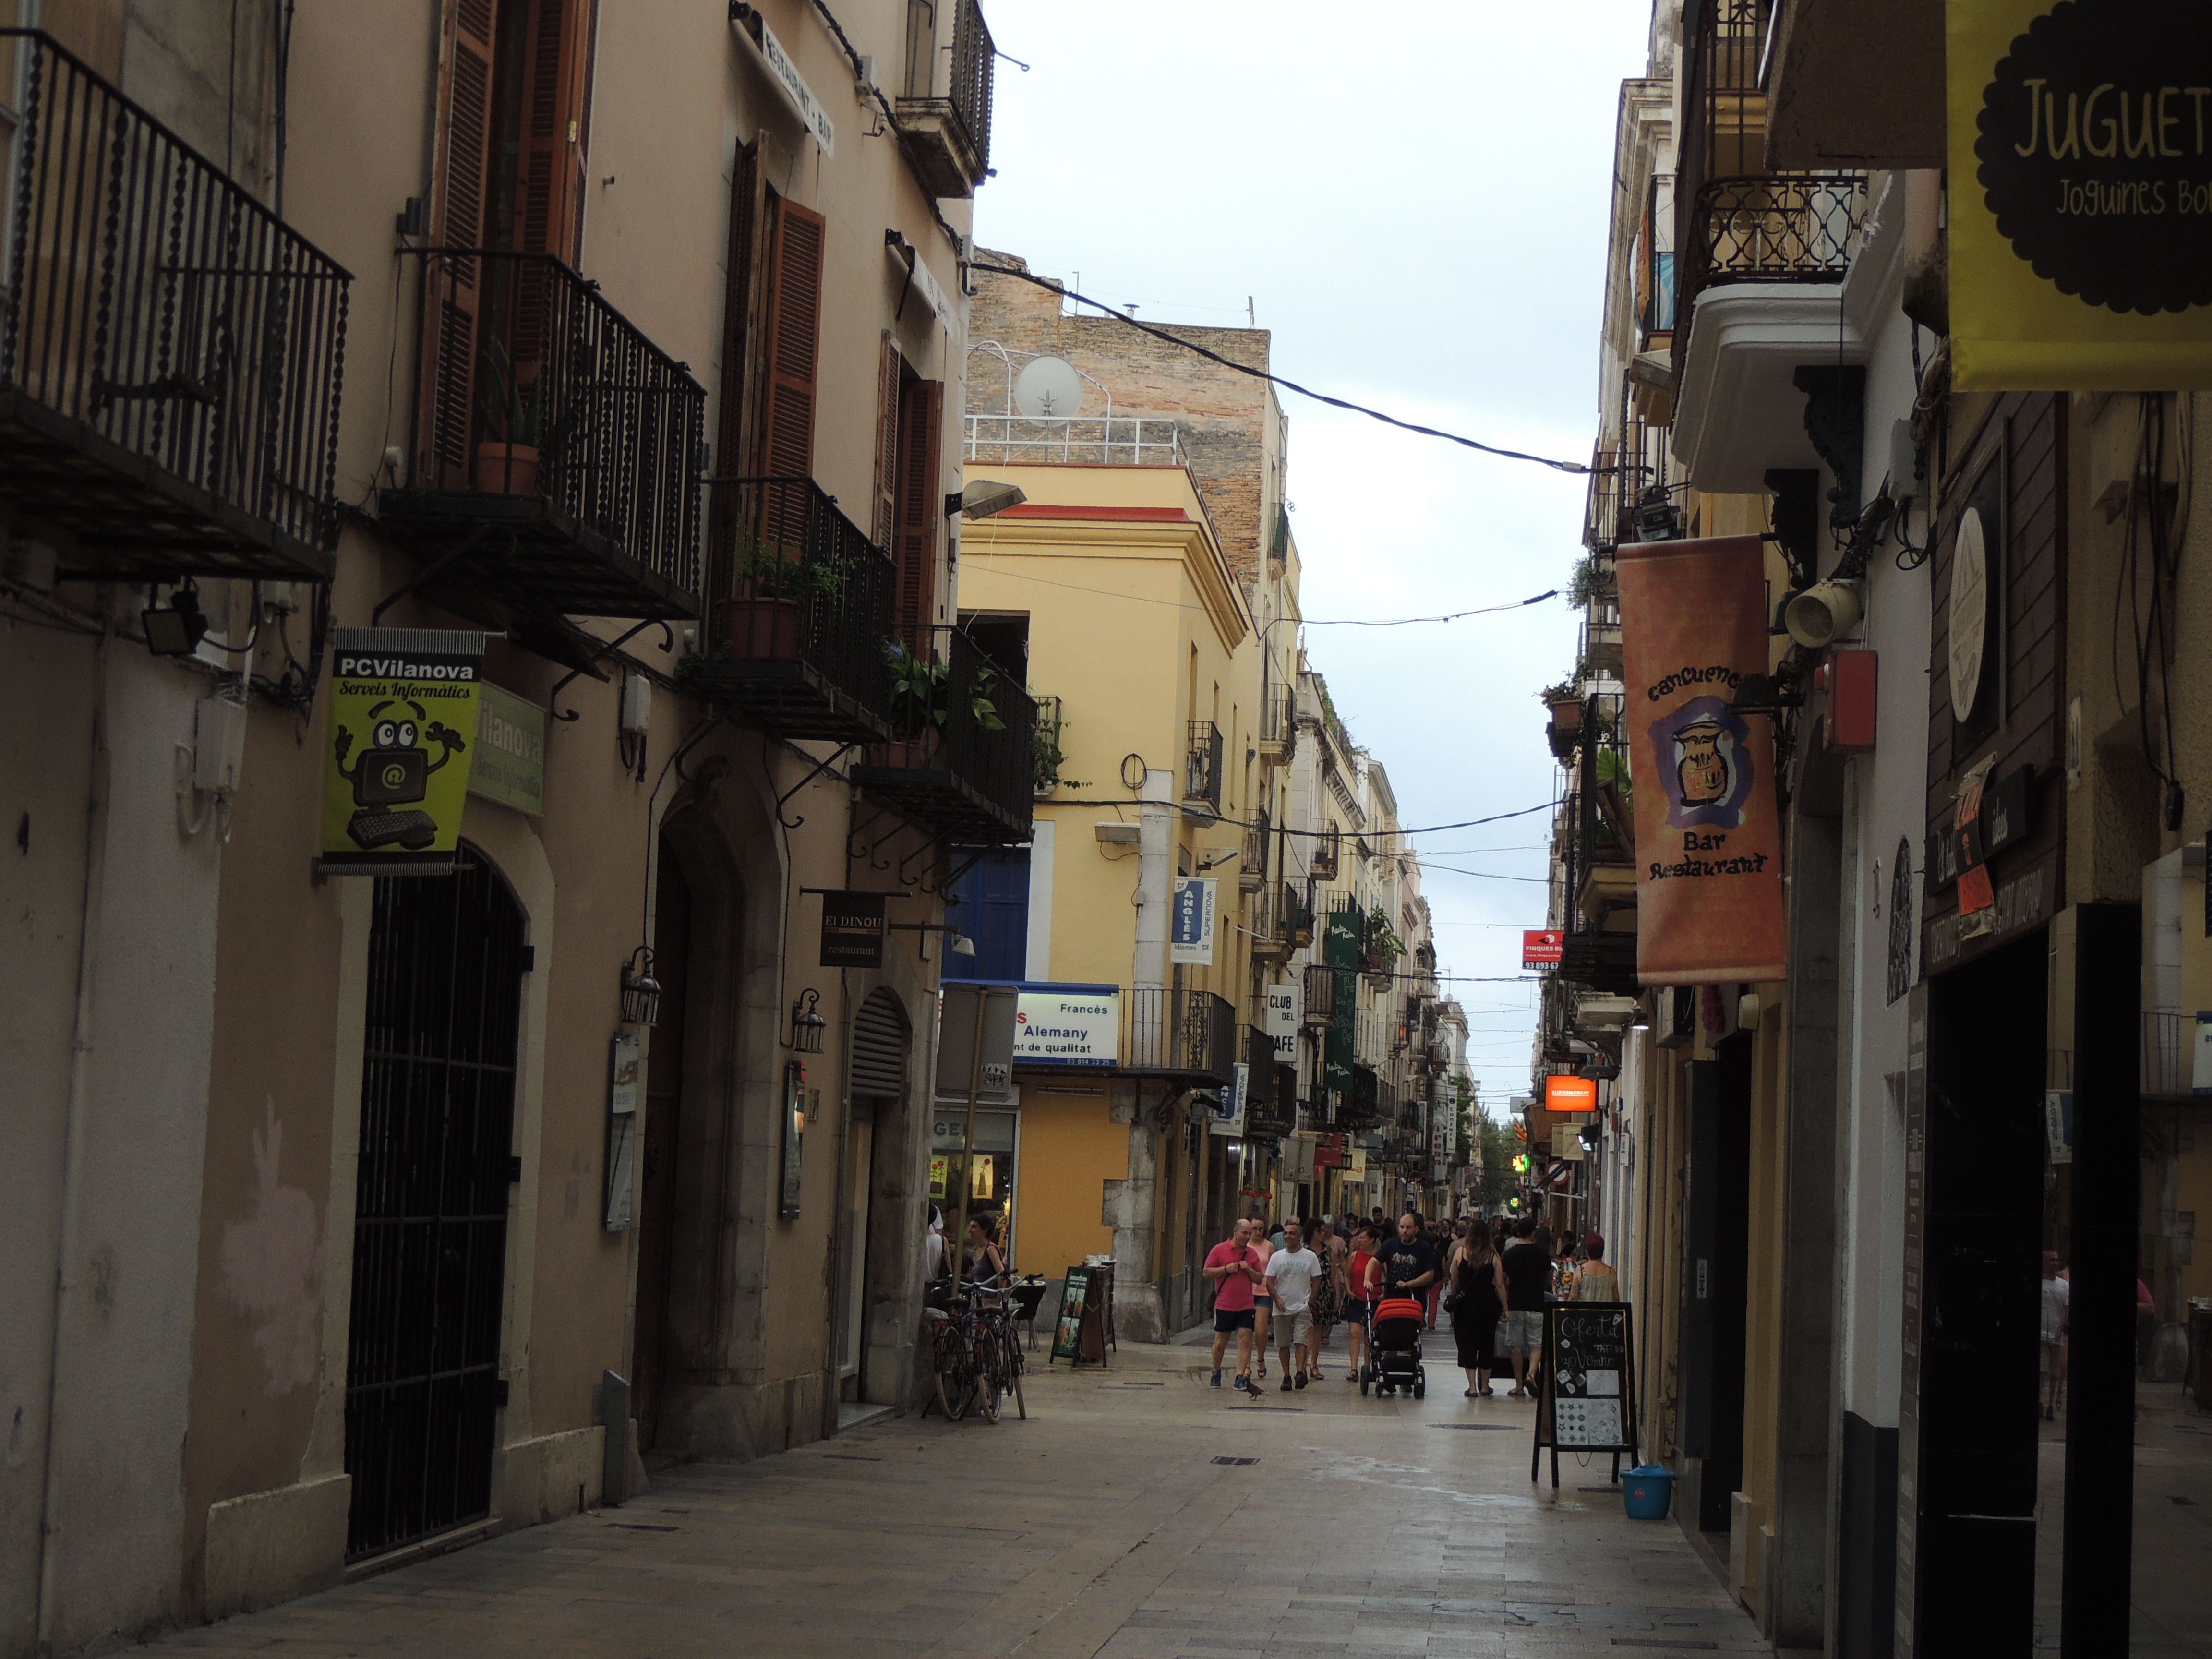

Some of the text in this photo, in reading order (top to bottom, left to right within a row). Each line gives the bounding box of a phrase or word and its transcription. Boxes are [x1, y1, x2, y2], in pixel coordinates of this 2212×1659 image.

[818, 111, 832, 145] BAR
[2014, 78, 2212, 160] JUGUET
[2056, 179, 2165, 216] Joguines
[340, 658, 474, 679] PCVilanova
[339, 681, 470, 701] Serveis Informàtics
[1683, 831, 1726, 851] Bar
[1649, 852, 1768, 881] Restaurant
[841, 916, 882, 928] DINOU
[1204, 890, 1213, 936] SUPERNOVA
[827, 946, 875, 955] restaurant
[1060, 1004, 1108, 1014] Francès
[1269, 994, 1292, 1009] CLUB
[1282, 1012, 1295, 1021] DEL
[1024, 1025, 1088, 1041] Alemany
[1028, 1043, 1041, 1051] de
[1045, 1043, 1091, 1054] qualitat
[1273, 1035, 1294, 1052] AFE
[1237, 1074, 1245, 1113] SUPERNOVA
[1561, 1315, 1619, 1343] Oferta
[1572, 1347, 1615, 1369] Verano
